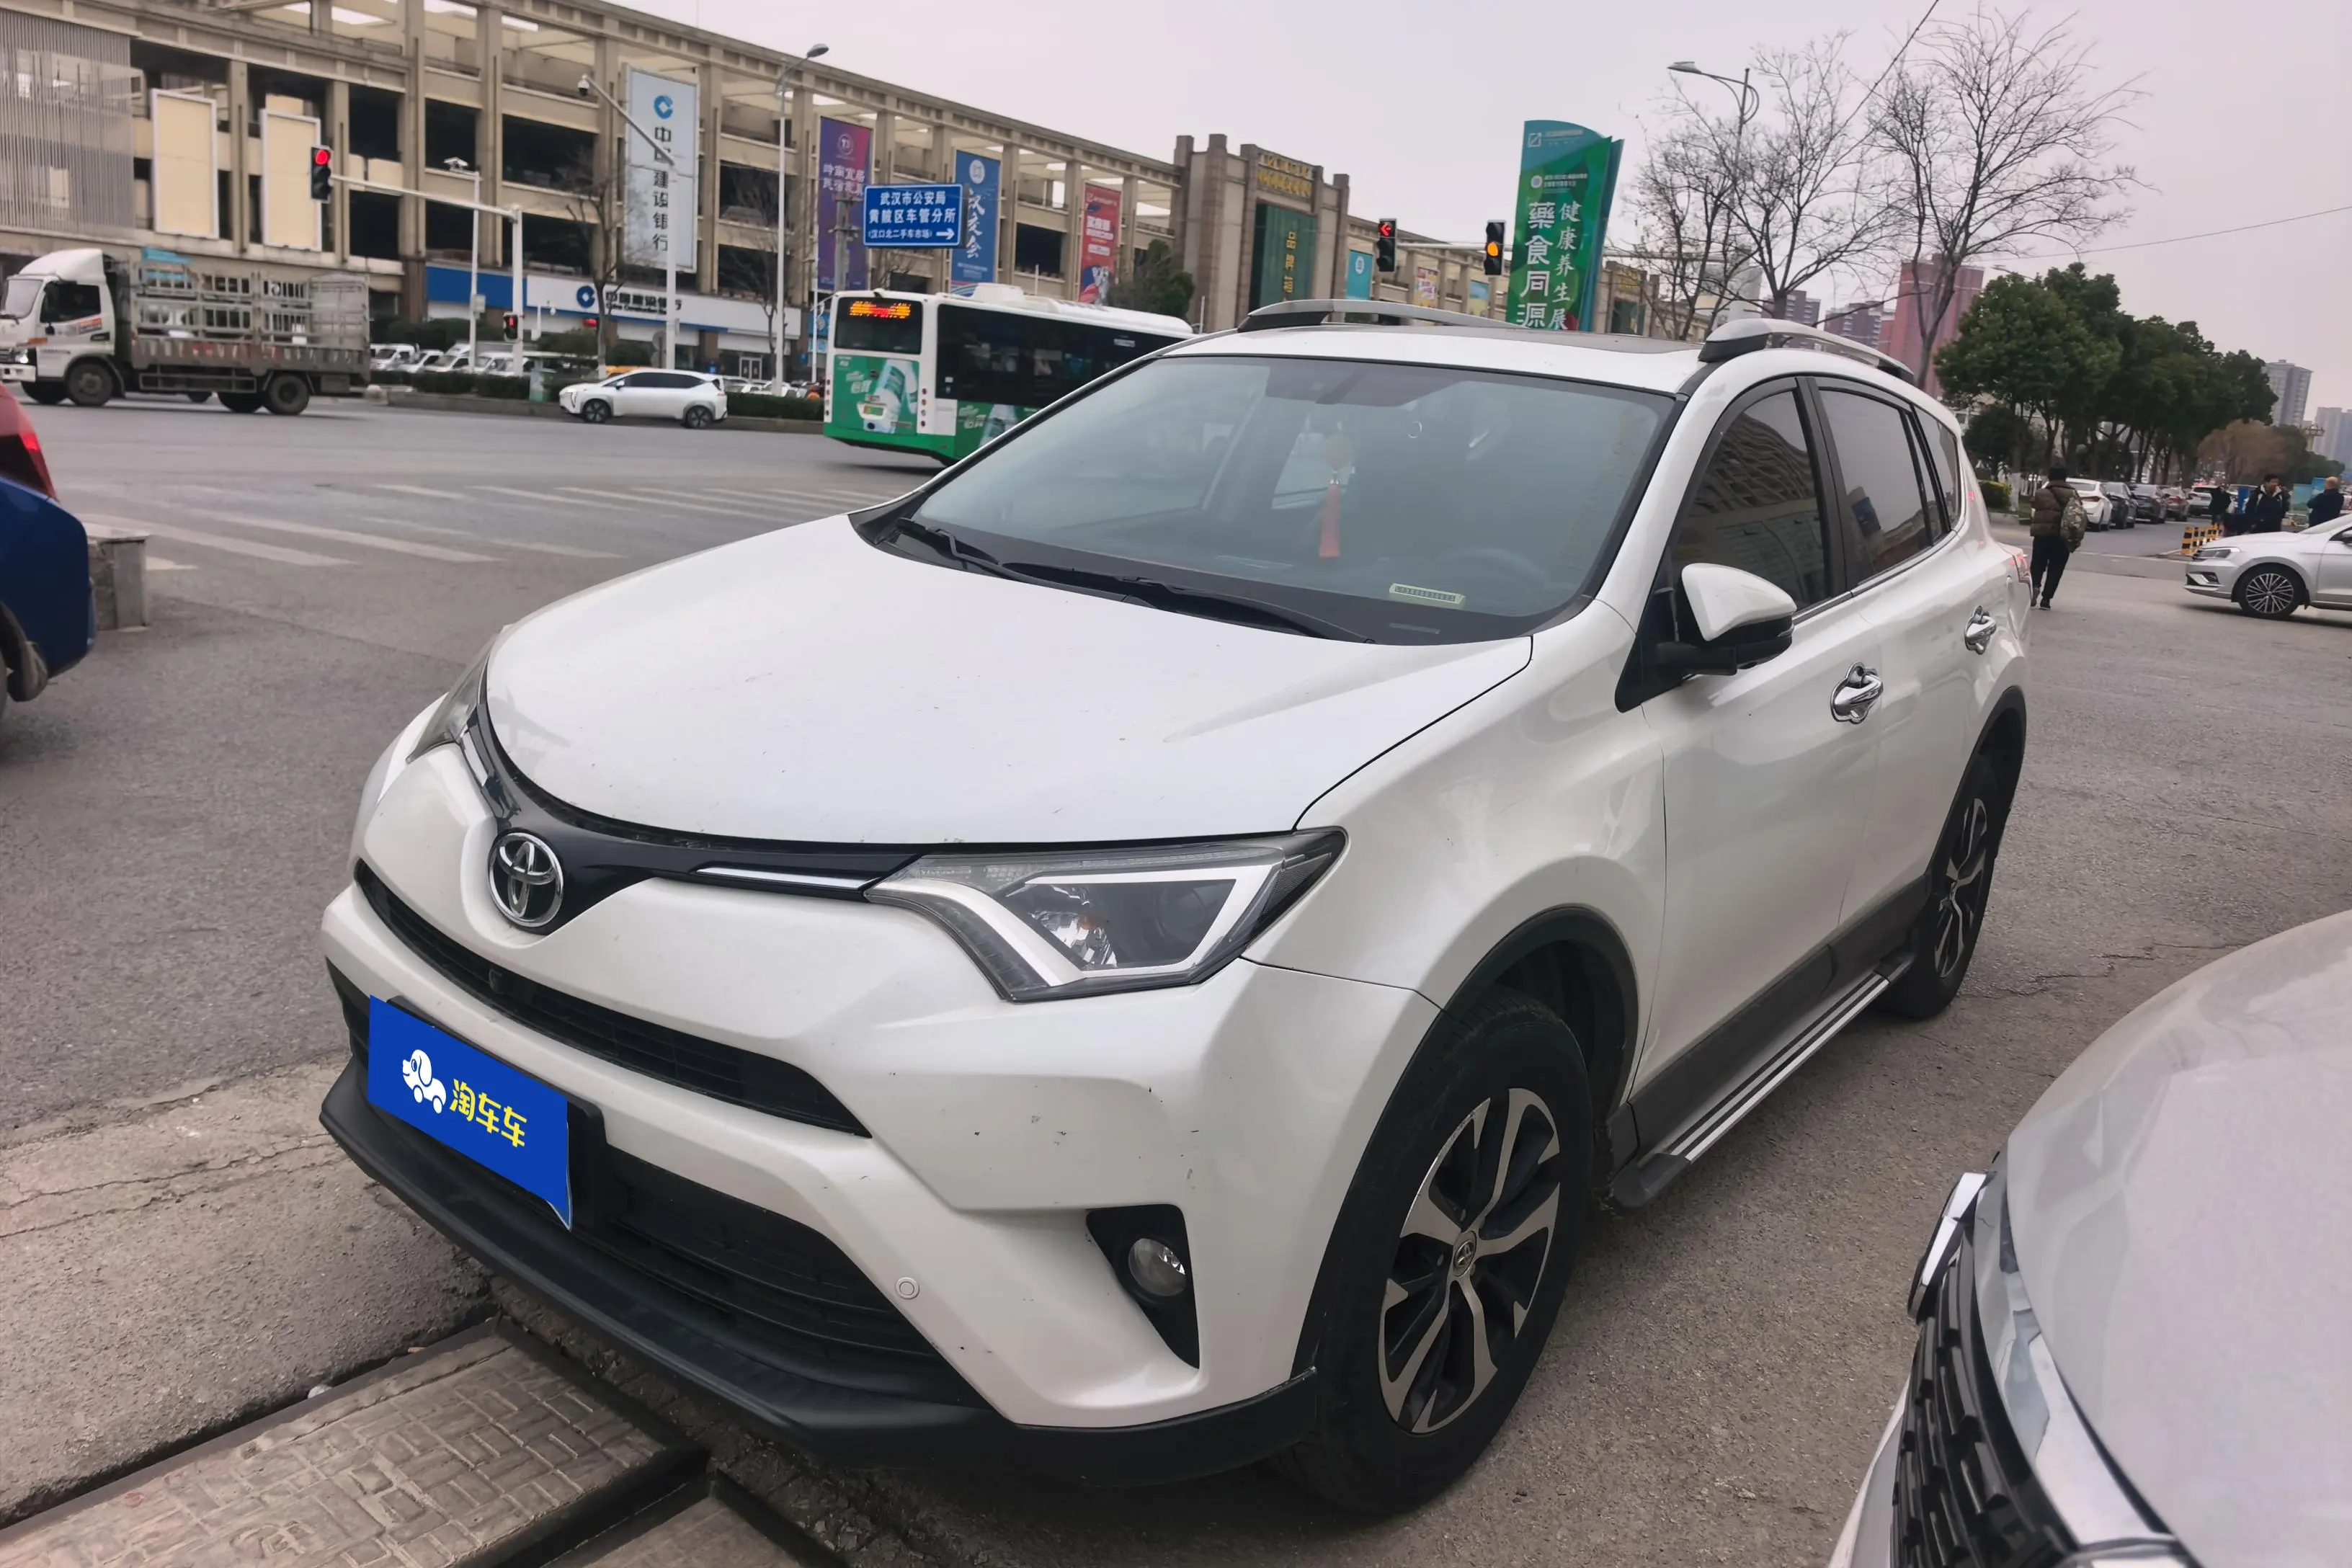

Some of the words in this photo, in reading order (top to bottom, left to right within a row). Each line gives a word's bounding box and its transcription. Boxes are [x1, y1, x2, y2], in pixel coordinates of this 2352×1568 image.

[868, 208, 957, 224] 黄陂区车管分所
[880, 190, 946, 206] 武汉市公安局
[1516, 202, 1556, 329] 藥食同源
[1548, 200, 1582, 331] 健康养生展
